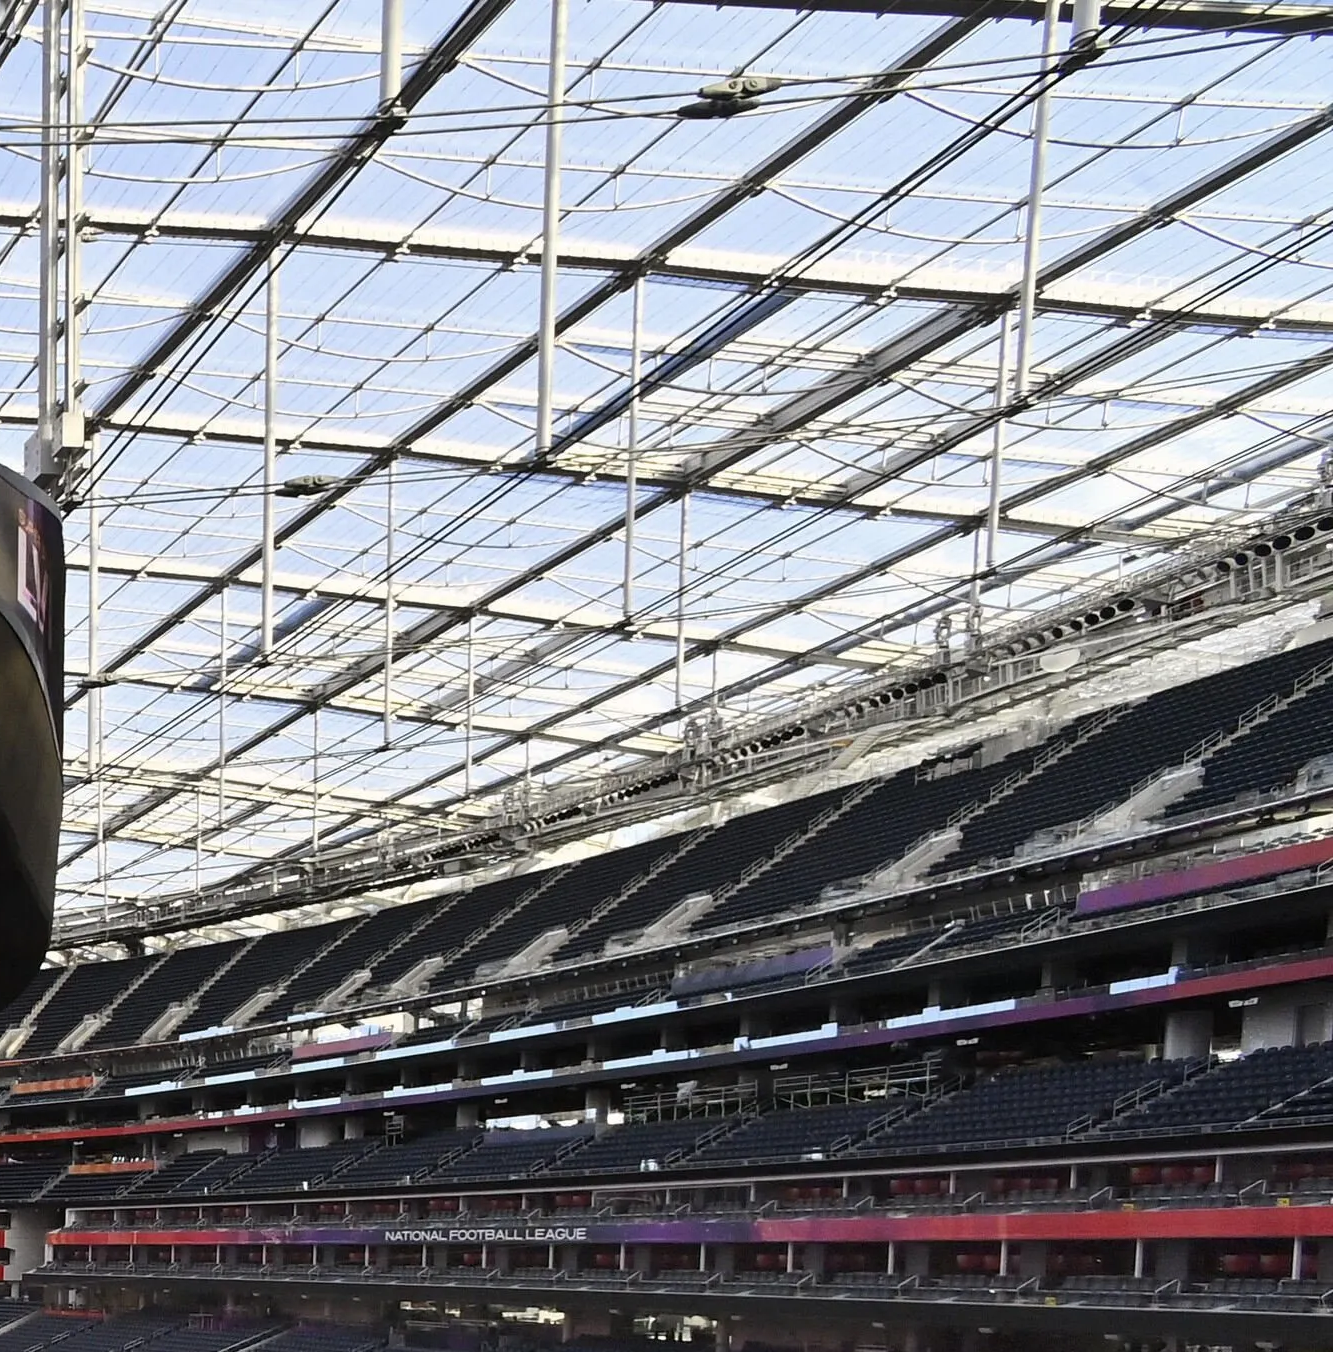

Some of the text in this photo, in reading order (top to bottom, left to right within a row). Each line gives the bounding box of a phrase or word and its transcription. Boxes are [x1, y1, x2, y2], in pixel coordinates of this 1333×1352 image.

[385, 1228, 587, 1241] NATIONAL FOOTBALL LEAGUE
